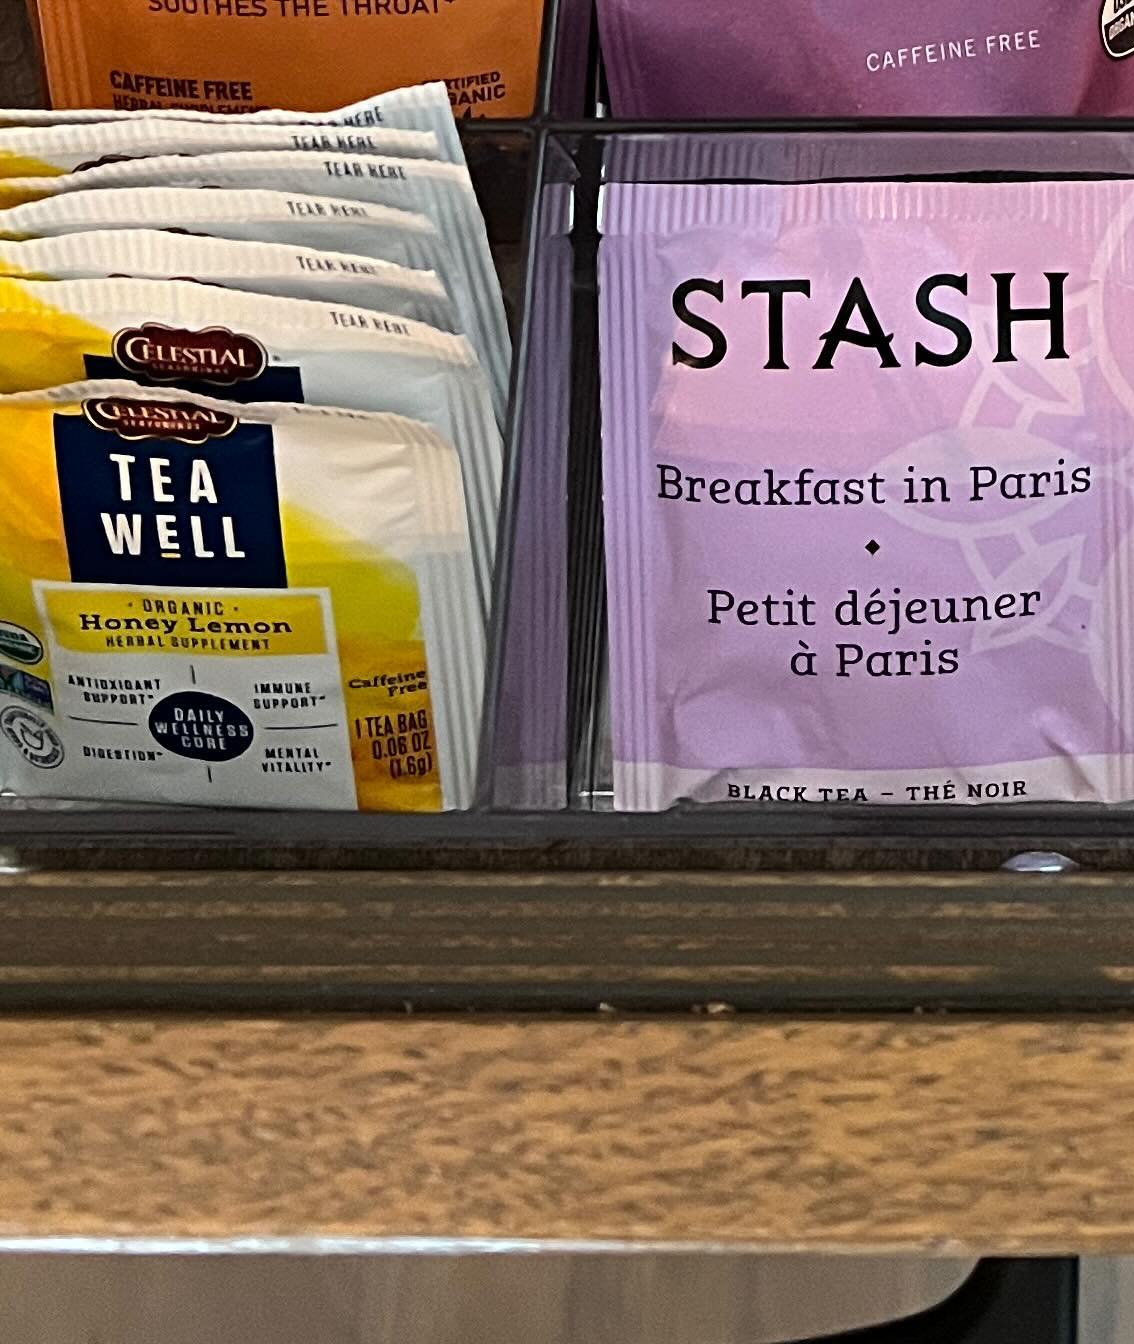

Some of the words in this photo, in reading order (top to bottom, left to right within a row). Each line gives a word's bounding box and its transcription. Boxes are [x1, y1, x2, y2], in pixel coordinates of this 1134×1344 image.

[866, 39, 976, 72] CAFFEINE
[986, 30, 1040, 55] FREE
[110, 70, 198, 100] CAFFEINE
[203, 77, 252, 100] FREE
[671, 272, 1069, 370] STASH
[110, 453, 218, 504] TEA
[657, 463, 886, 508] Breakfast
[904, 465, 950, 503] in
[968, 459, 1092, 501] Paris
[100, 512, 246, 559] WELL
[80, 614, 178, 633] Honey
[189, 616, 292, 634] Lemon
[144, 599, 224, 615] ORGANIC
[707, 588, 815, 627] Petit
[835, 587, 1041, 635] déjeuner
[106, 635, 165, 649] HERBAL
[171, 637, 270, 650] SUPPLEMENT
[790, 640, 817, 677] à
[836, 640, 960, 678] Paris
[366, 715, 395, 736] TEA
[399, 710, 426, 734] BAG
[372, 738, 407, 760] 0.06
[411, 732, 431, 753] OZ
[727, 783, 810, 803] BLACK
[818, 787, 868, 803] TEA
[906, 781, 957, 802] THÉ
[966, 780, 1027, 799] NOIR
